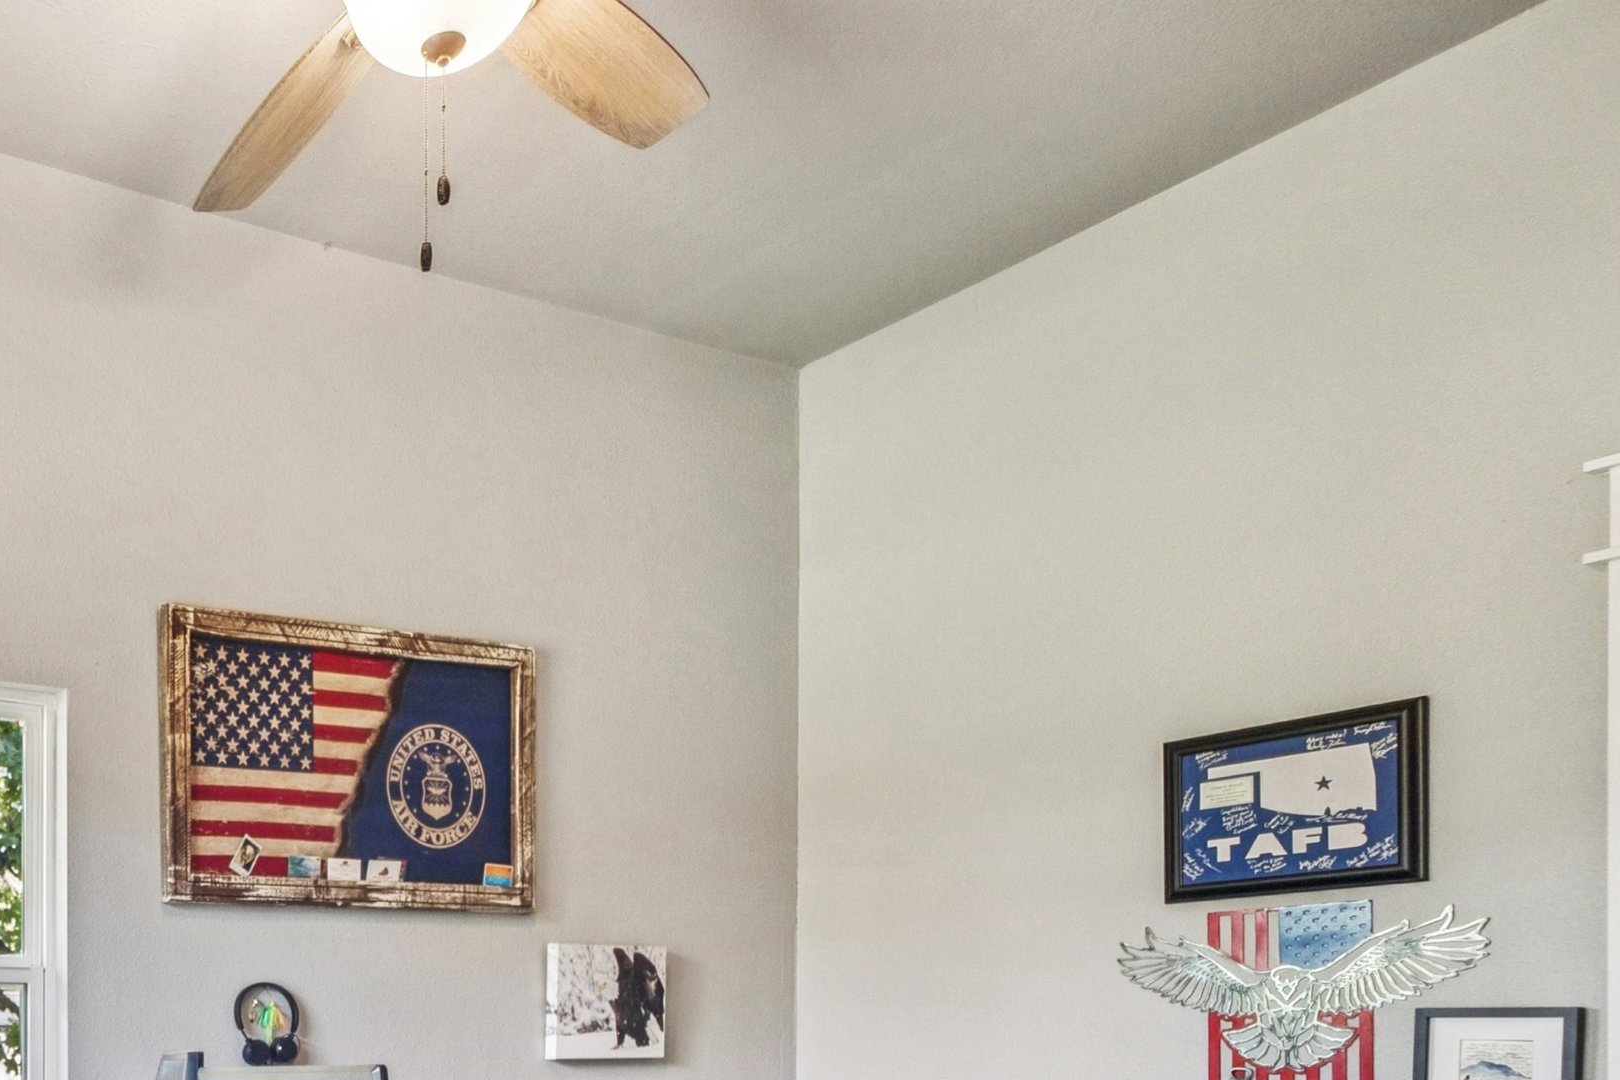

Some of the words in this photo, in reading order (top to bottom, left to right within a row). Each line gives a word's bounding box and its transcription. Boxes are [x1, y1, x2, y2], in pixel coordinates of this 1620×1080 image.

[390, 728, 436, 782] UNITED
[440, 729, 483, 789] STATES
[391, 799, 420, 836] AIR
[419, 811, 478, 846] FORCE
[1207, 822, 1368, 863] TAFB
